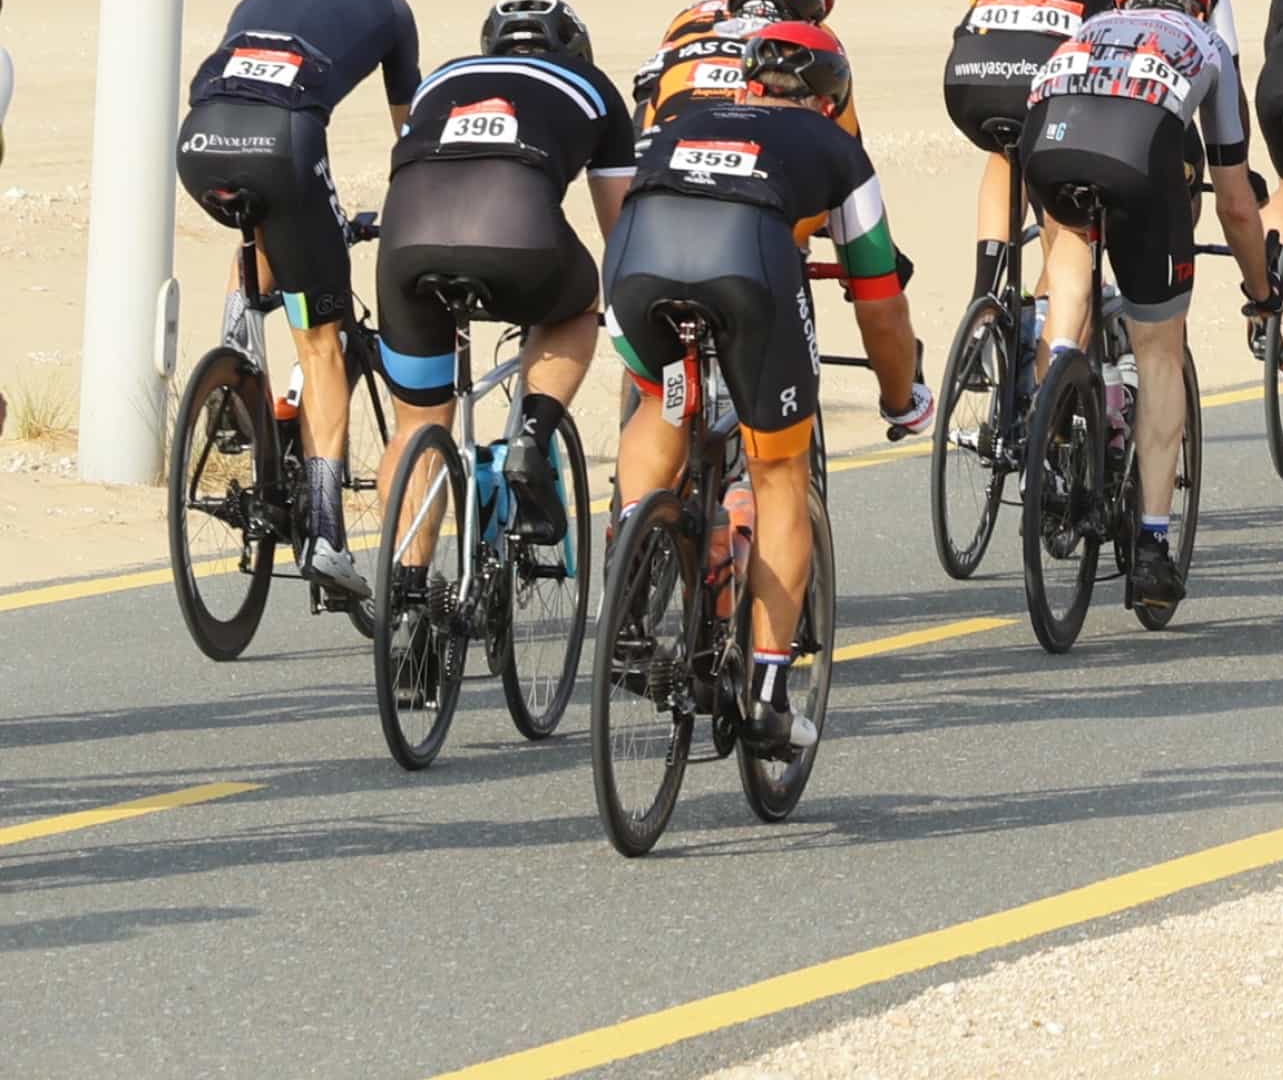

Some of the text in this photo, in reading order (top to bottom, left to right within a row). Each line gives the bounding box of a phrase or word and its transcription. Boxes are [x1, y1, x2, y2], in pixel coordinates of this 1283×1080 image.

[980, 8, 1019, 24] 401
[1031, 8, 1071, 29] 401
[678, 41, 720, 59] YAS
[236, 60, 286, 79] 357
[707, 68, 744, 84] 40
[1140, 56, 1182, 87] 361
[454, 117, 505, 137] 396
[208, 134, 276, 147] EVOLUTEC
[685, 151, 742, 169] 359
[666, 373, 684, 409] 359
